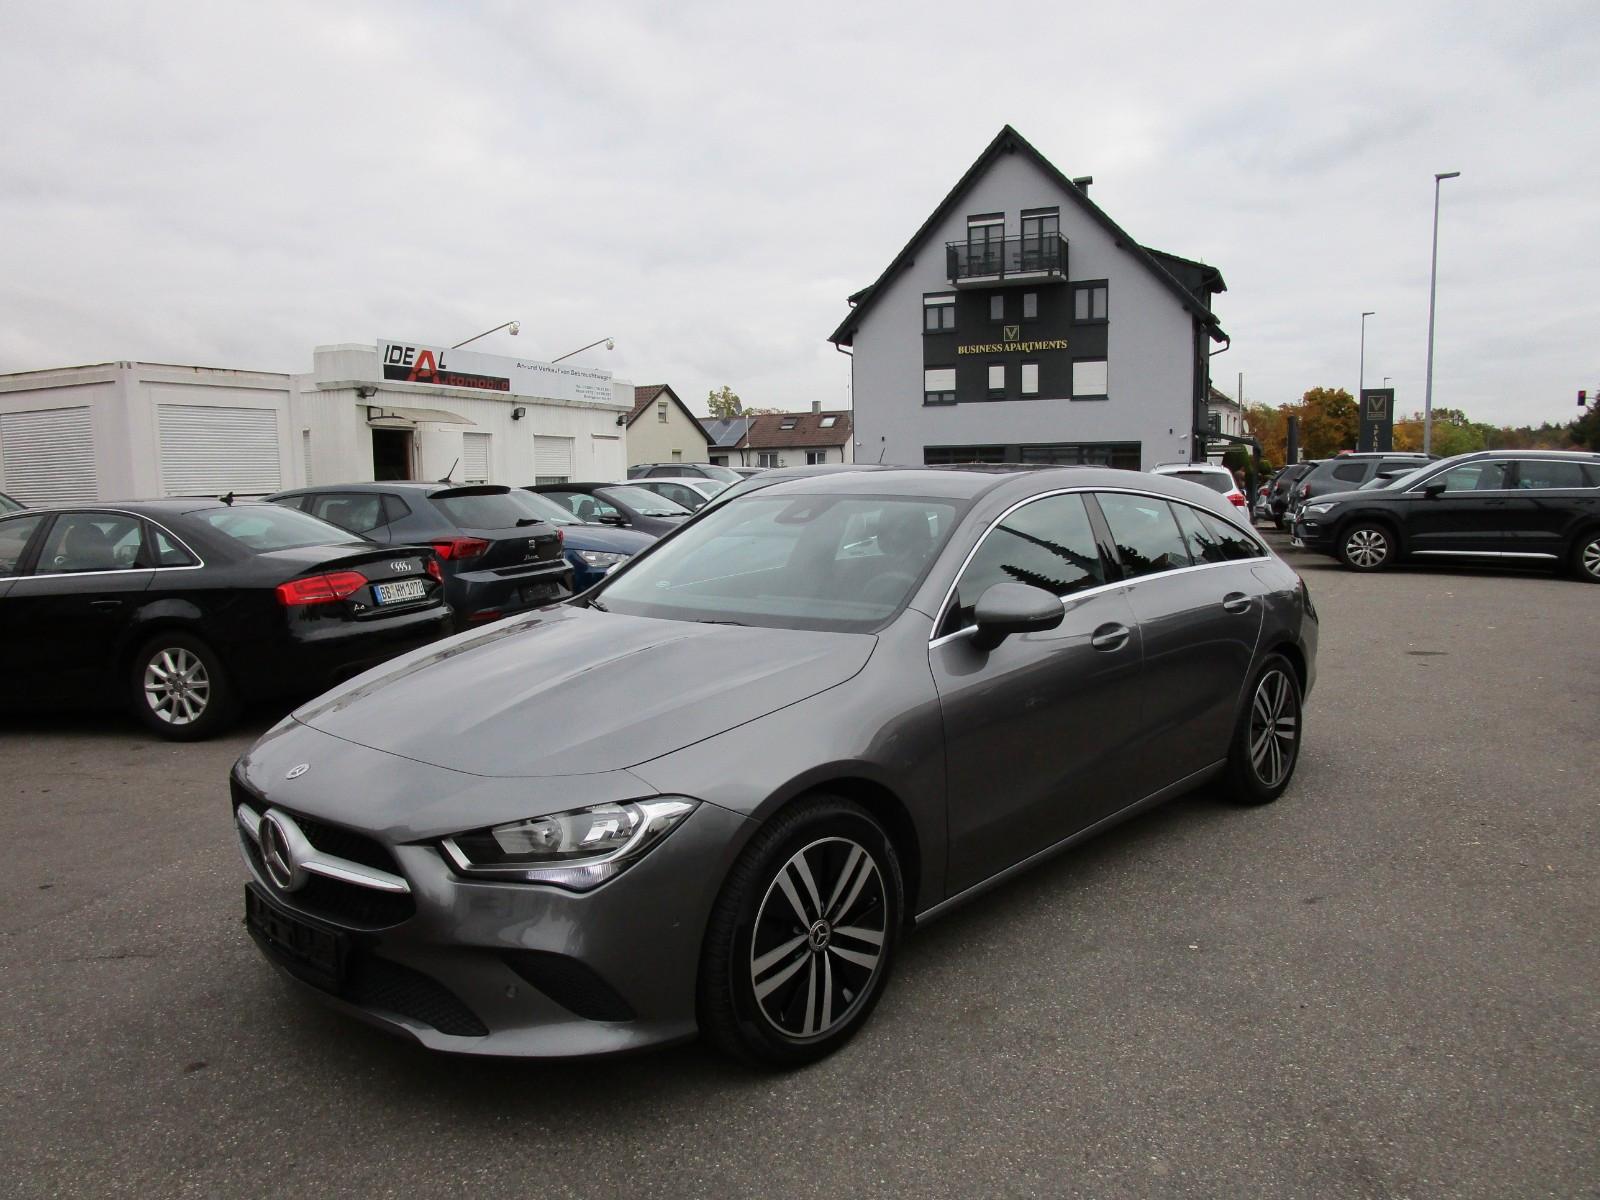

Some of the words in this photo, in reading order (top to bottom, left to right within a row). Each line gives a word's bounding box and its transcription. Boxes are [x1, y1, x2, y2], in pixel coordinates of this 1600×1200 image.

[958, 343, 1003, 355] BUSINESS
[1004, 340, 1068, 353] APARTMENTS
[383, 344, 446, 383] IDEAL
[379, 585, 392, 600] BB
